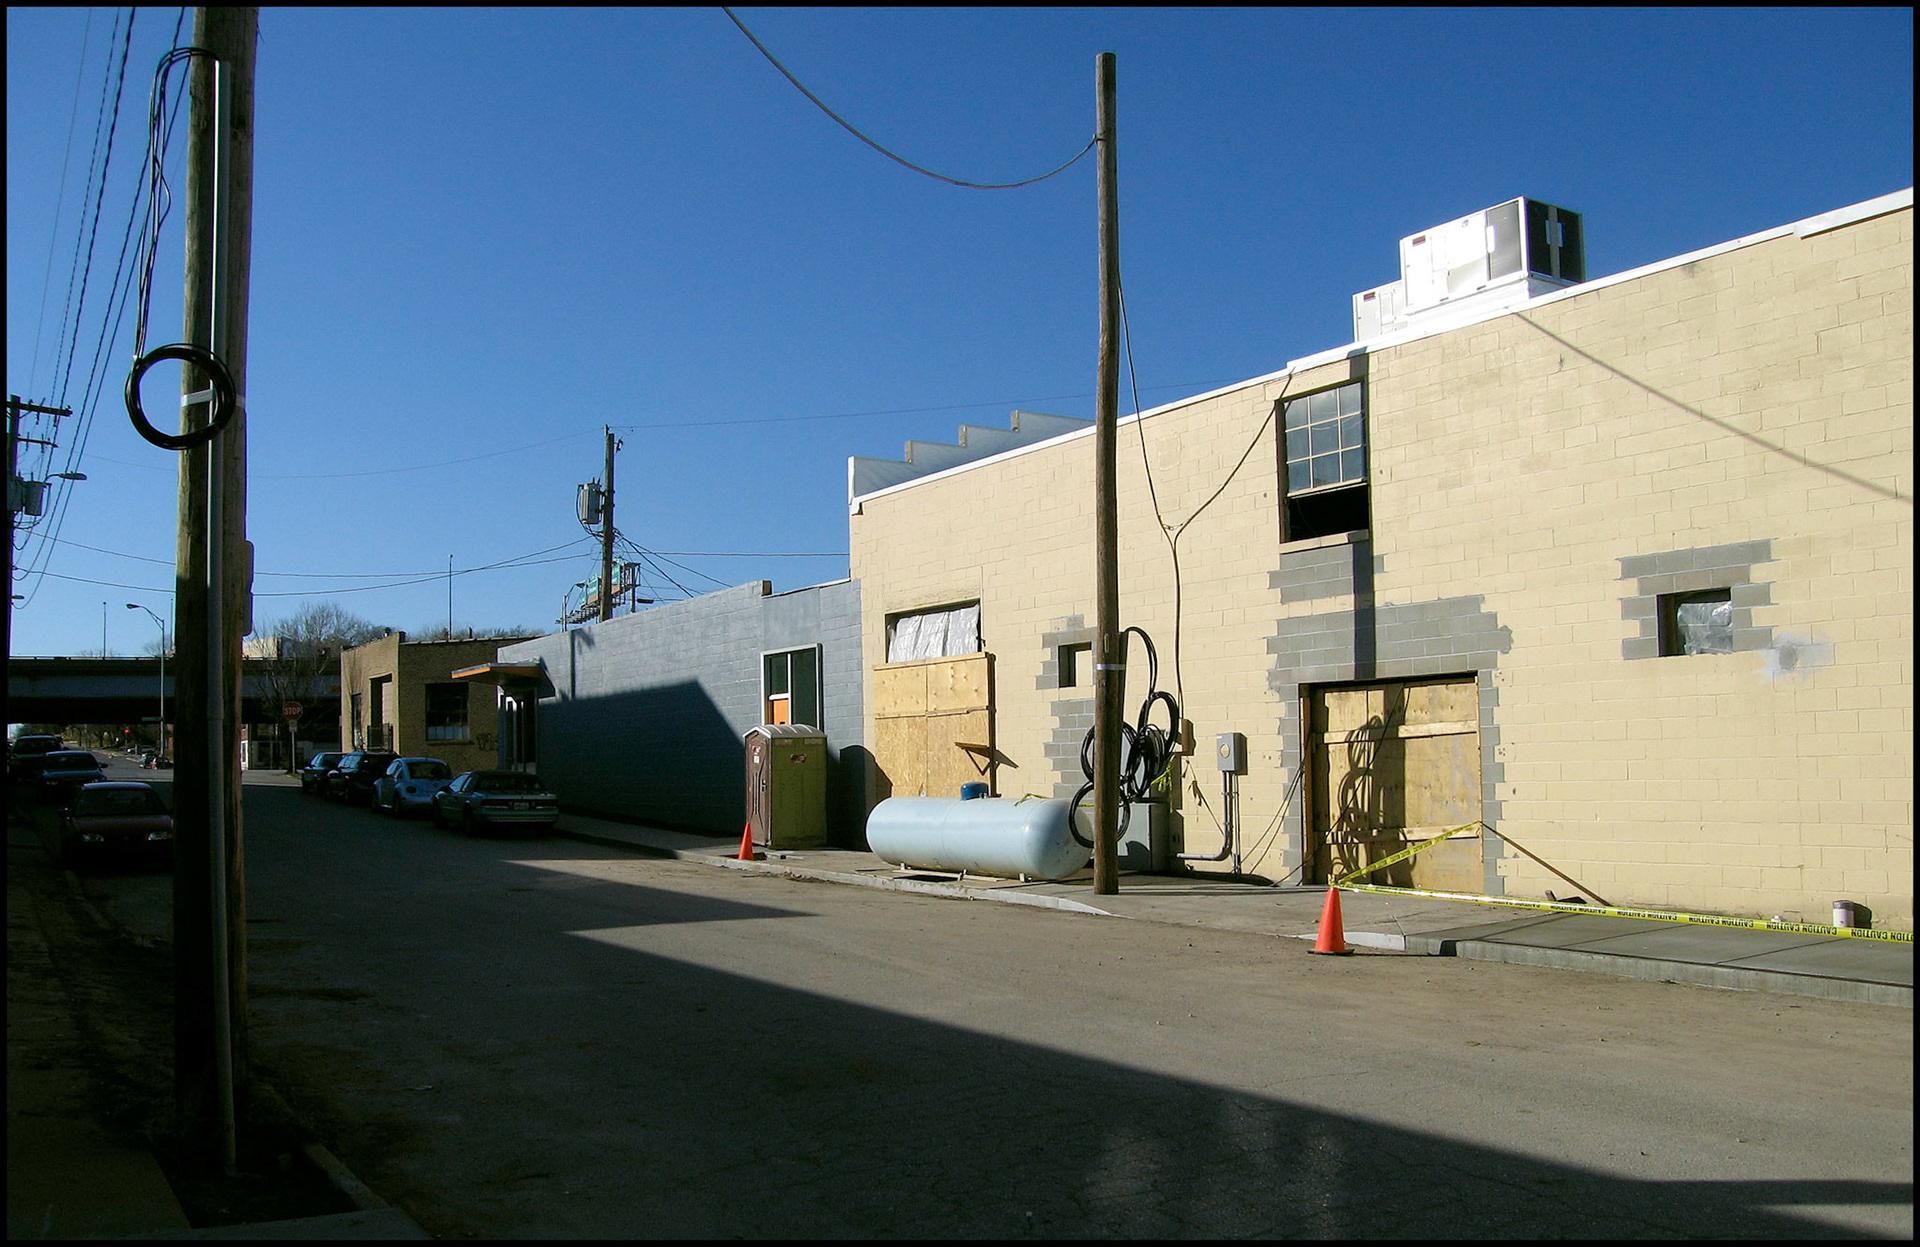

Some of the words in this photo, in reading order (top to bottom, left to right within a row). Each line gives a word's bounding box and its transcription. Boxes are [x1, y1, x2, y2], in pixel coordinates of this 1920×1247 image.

[284, 707, 301, 715] STOP
[1688, 914, 1720, 925] CAUTION
[1721, 917, 1754, 928] CAUTION
[1766, 921, 1800, 932] CAUTION
[1802, 924, 1837, 935] CAUTION
[1850, 928, 1888, 940] CAUTION
